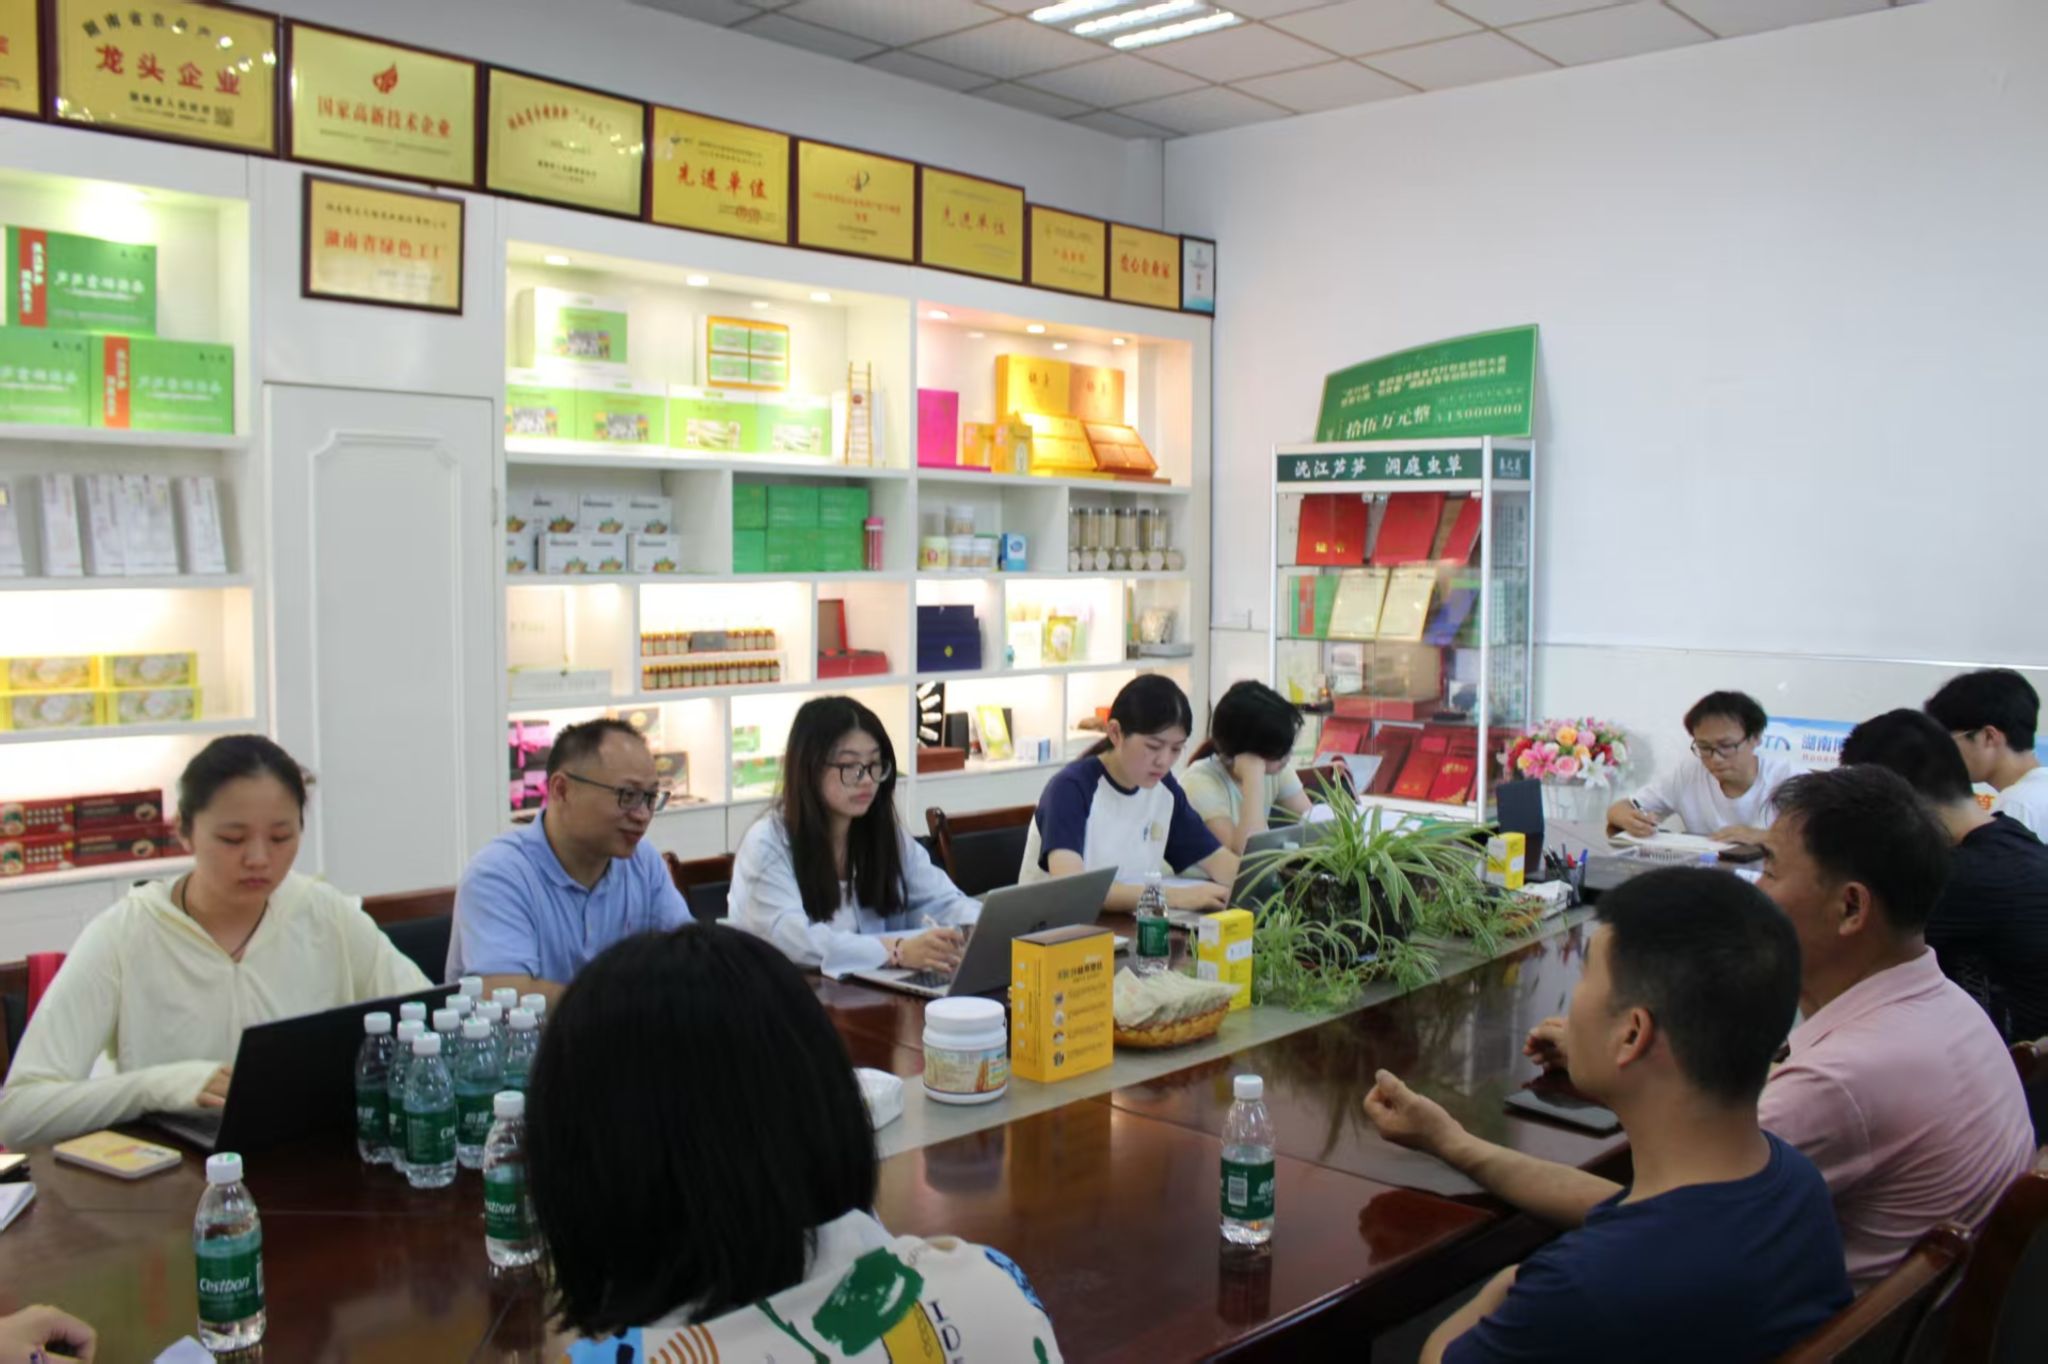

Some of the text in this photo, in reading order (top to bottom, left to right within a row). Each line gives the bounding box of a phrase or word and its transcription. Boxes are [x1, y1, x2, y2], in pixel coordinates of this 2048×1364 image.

[96, 44, 241, 96] 龙头企业
[317, 95, 452, 139] 国家高新技术企业
[678, 162, 767, 199] 先进单位
[324, 228, 443, 261] 湖南省绿色工厂
[1294, 454, 1463, 479] 沅江芦笋 洞庭虫草
[926, 1299, 965, 1364] ID
